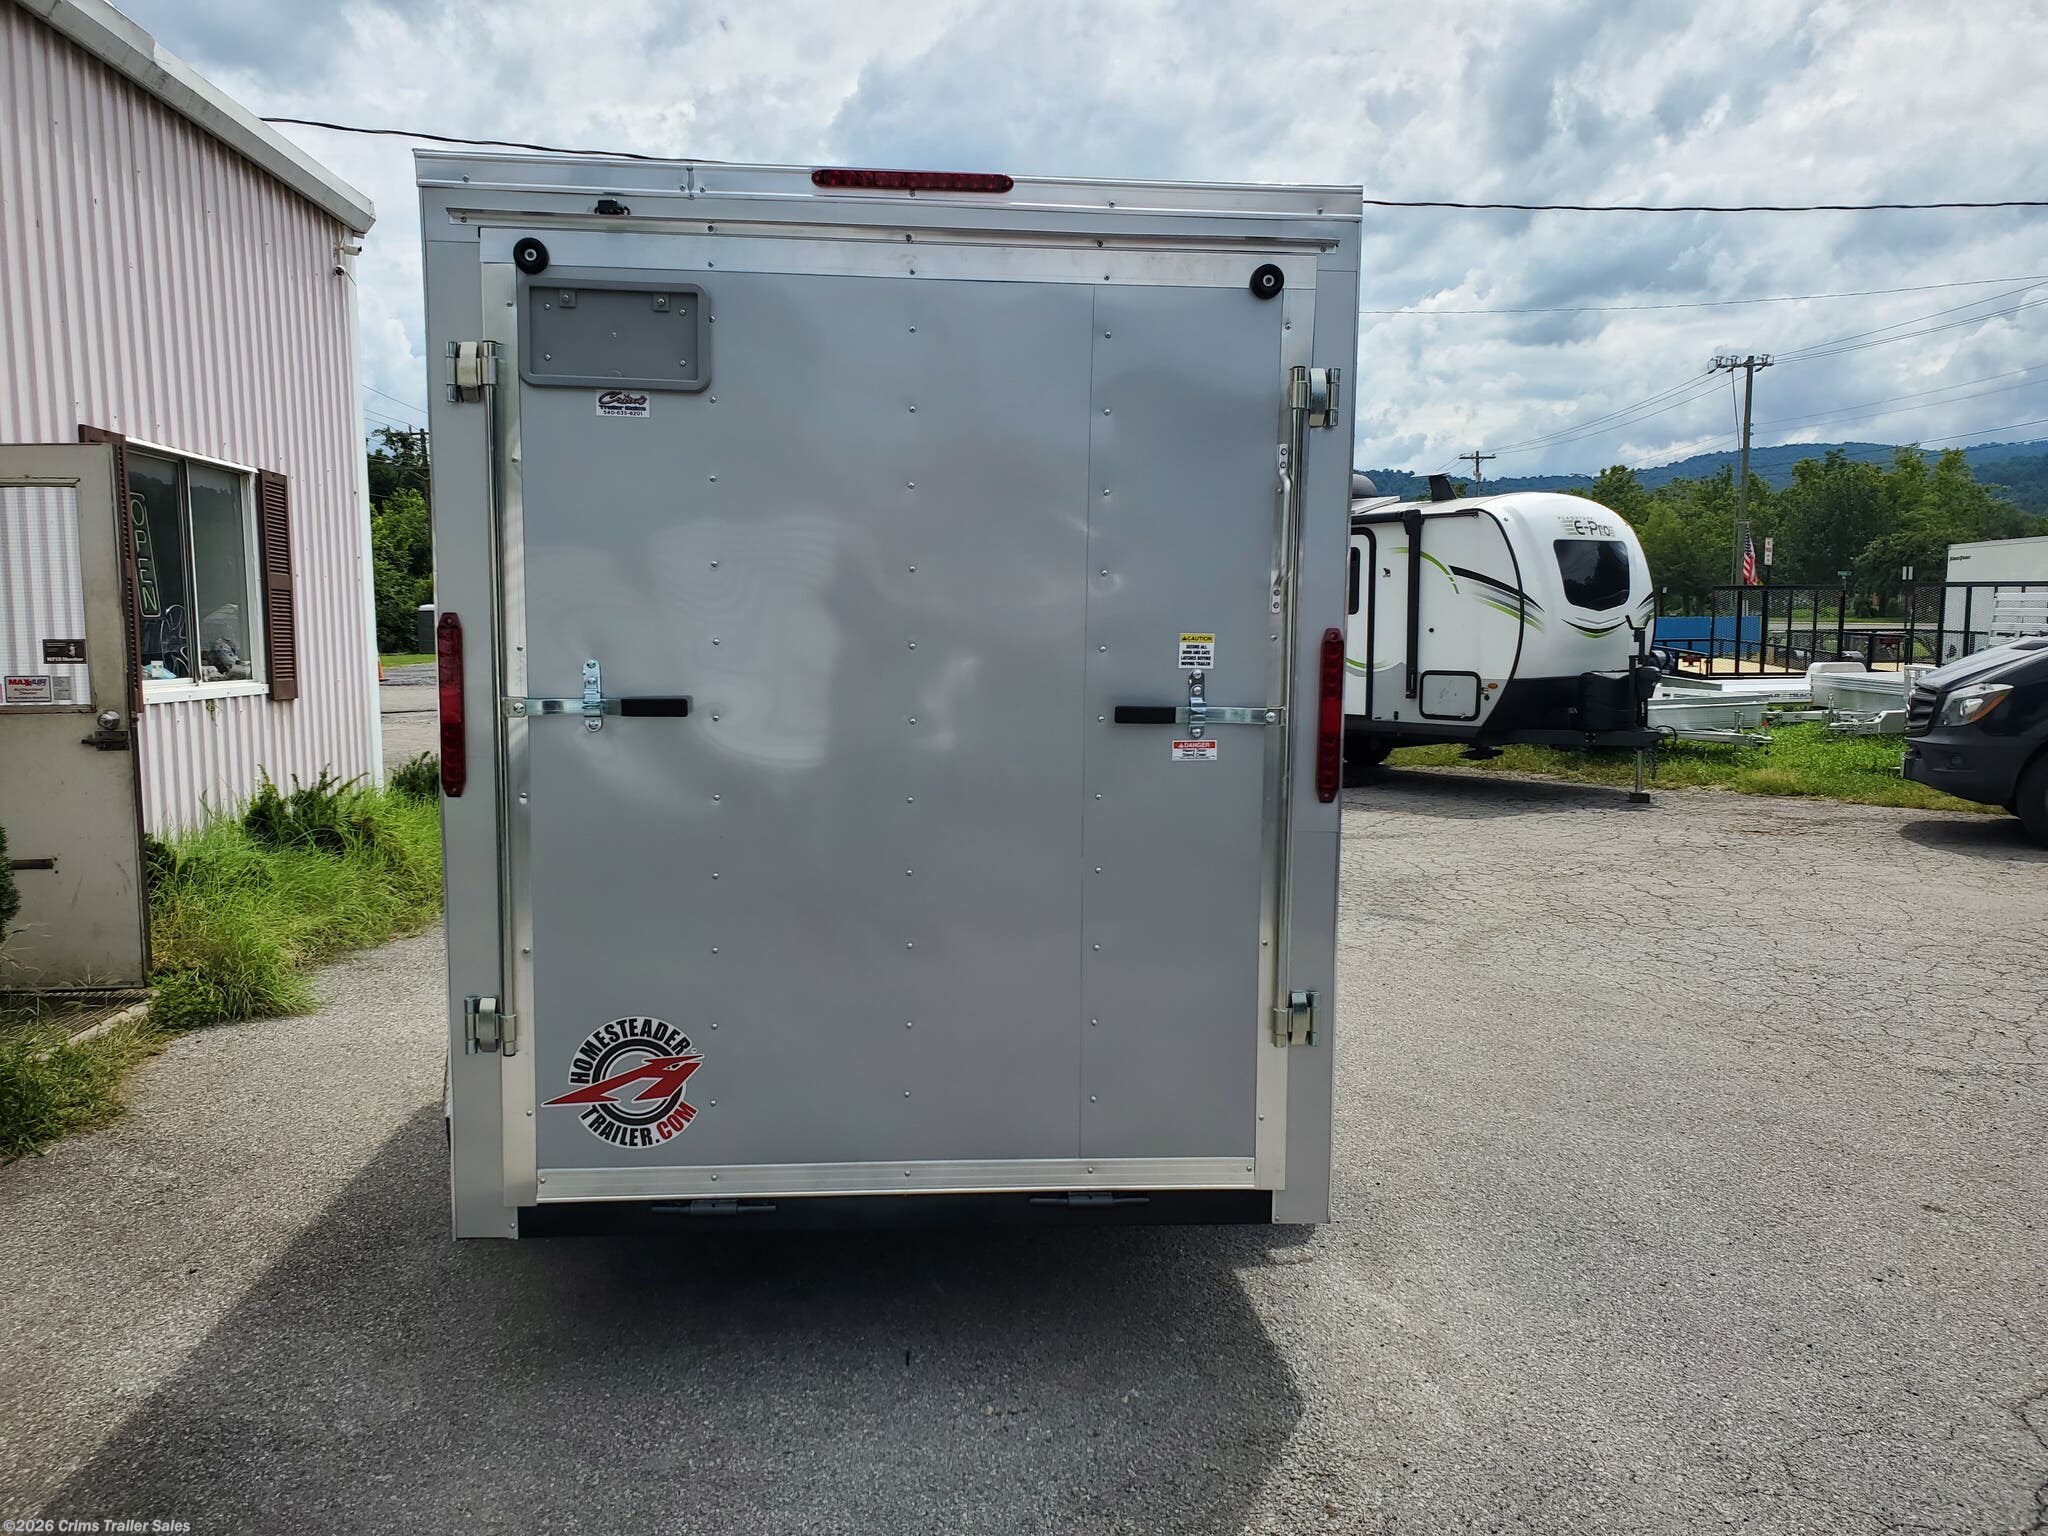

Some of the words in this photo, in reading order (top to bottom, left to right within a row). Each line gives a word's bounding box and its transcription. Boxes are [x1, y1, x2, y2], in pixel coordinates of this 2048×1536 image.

[131, 499, 158, 611] OPEN
[570, 1018, 691, 1084] HOMESTEADER
[580, 1101, 698, 1147] TRAILER.COM
